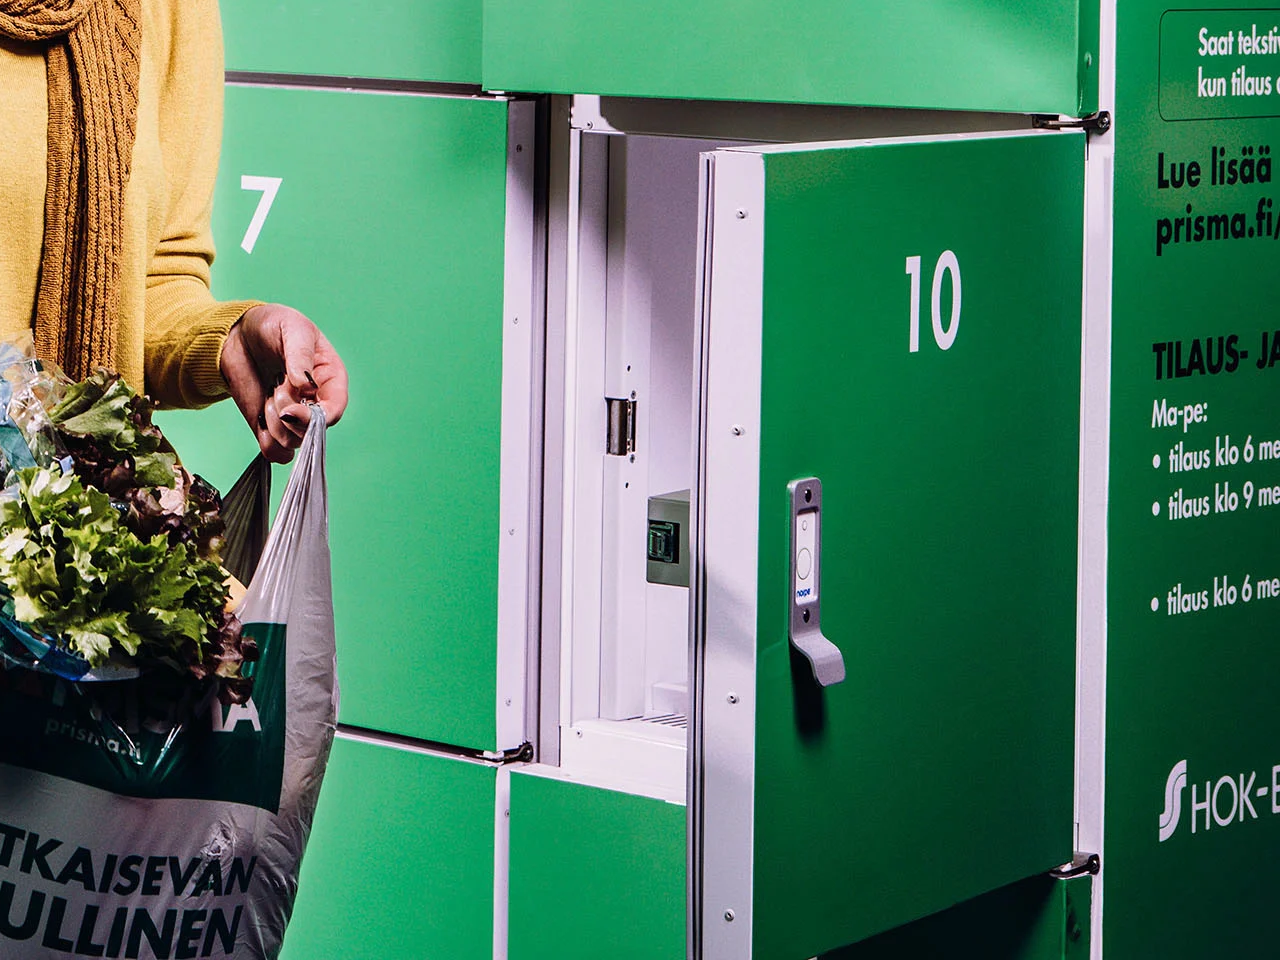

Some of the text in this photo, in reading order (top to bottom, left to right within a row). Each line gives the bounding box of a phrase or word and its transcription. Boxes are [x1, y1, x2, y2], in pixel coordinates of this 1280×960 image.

[1198, 27, 1234, 57] Saat
[1197, 66, 1227, 98] kun
[1231, 65, 1272, 96] tilaus
[1157, 145, 1272, 189] Lue lisää
[240, 175, 283, 254] 7
[905, 250, 962, 353] 10
[1152, 334, 1248, 381] TILAUS-
[1151, 398, 1208, 433] Ma-pe:
[1169, 441, 1210, 473] tilaus
[1215, 435, 1239, 467] klo
[1243, 435, 1254, 463] 6
[1168, 488, 1210, 520] tilaus
[1215, 481, 1238, 513] klo
[1242, 480, 1254, 509] 9
[1167, 583, 1209, 616] tilaus
[1213, 575, 1237, 608] klo
[1241, 574, 1252, 602] 6
